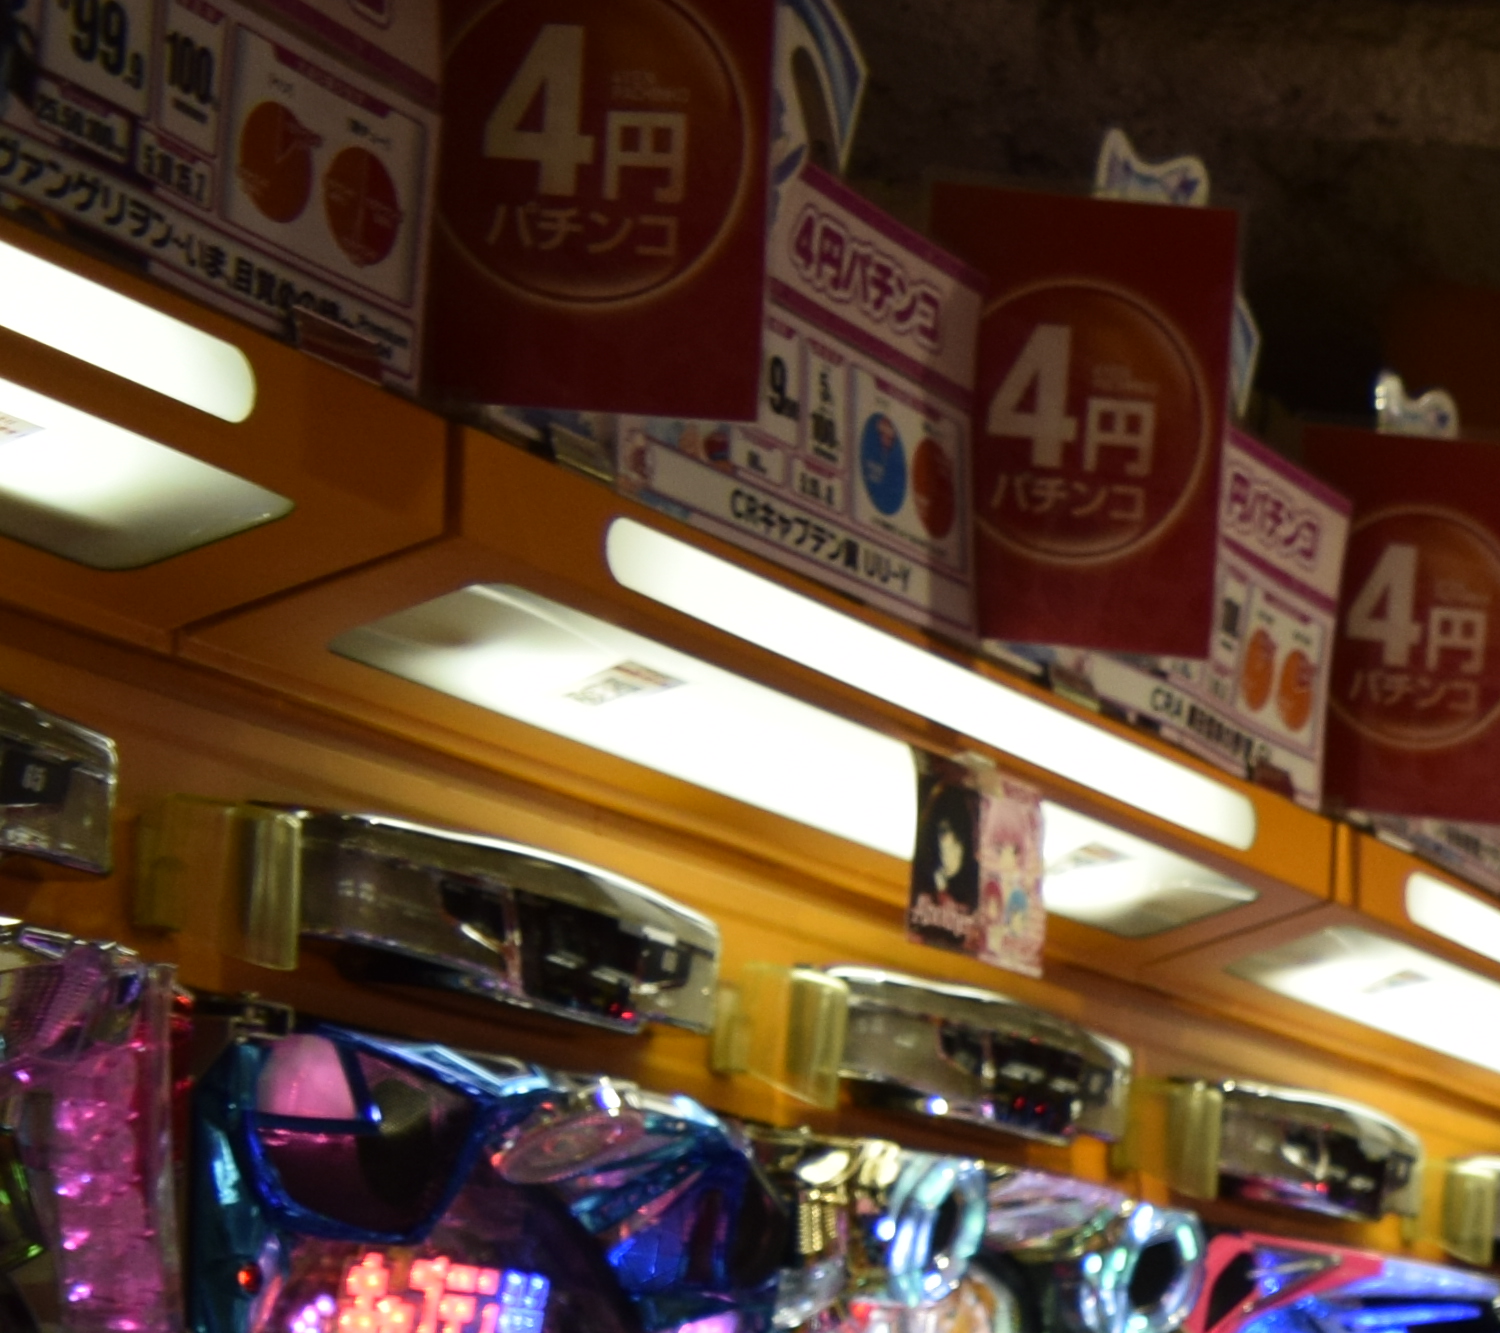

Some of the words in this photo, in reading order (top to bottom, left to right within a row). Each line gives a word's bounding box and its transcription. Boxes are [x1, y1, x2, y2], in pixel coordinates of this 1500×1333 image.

[482, 23, 687, 204] 4円
[485, 202, 679, 257] パチンコ
[796, 214, 941, 345] 4円パチンコ
[986, 323, 1157, 477] 4円
[991, 472, 1145, 522] パチンコ
[1346, 543, 1488, 674] 4円
[1350, 668, 1480, 713] パチンコ
